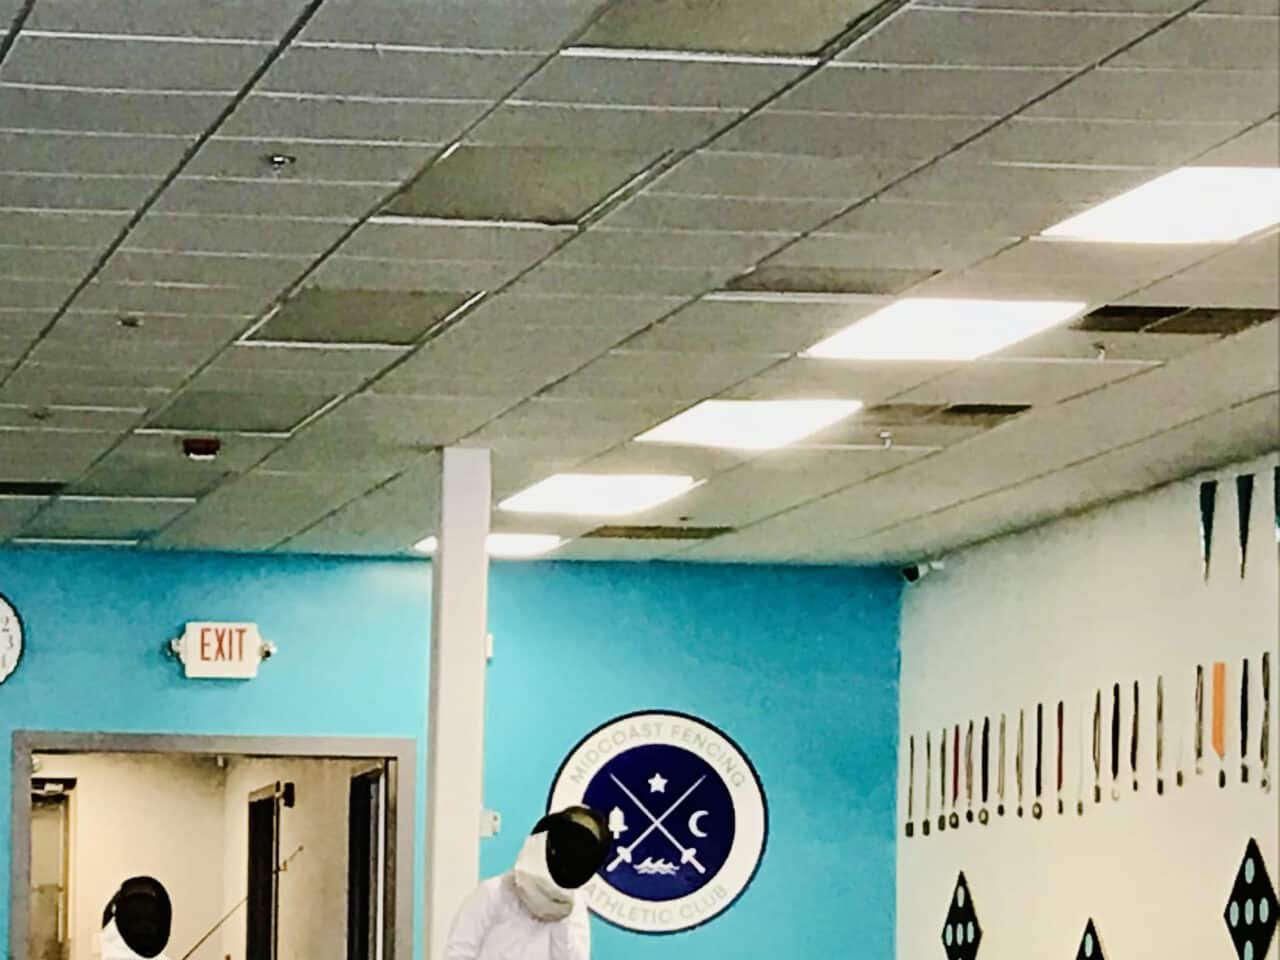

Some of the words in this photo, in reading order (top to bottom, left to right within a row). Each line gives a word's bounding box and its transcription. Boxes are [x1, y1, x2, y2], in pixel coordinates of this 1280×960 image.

[1, 615, 10, 633] 2
[201, 627, 247, 661] EXIT
[570, 722, 665, 785] MIDCOAST
[670, 723, 746, 788] FENCING
[585, 882, 673, 924] ATHLETIC
[679, 884, 729, 920] CLUB
